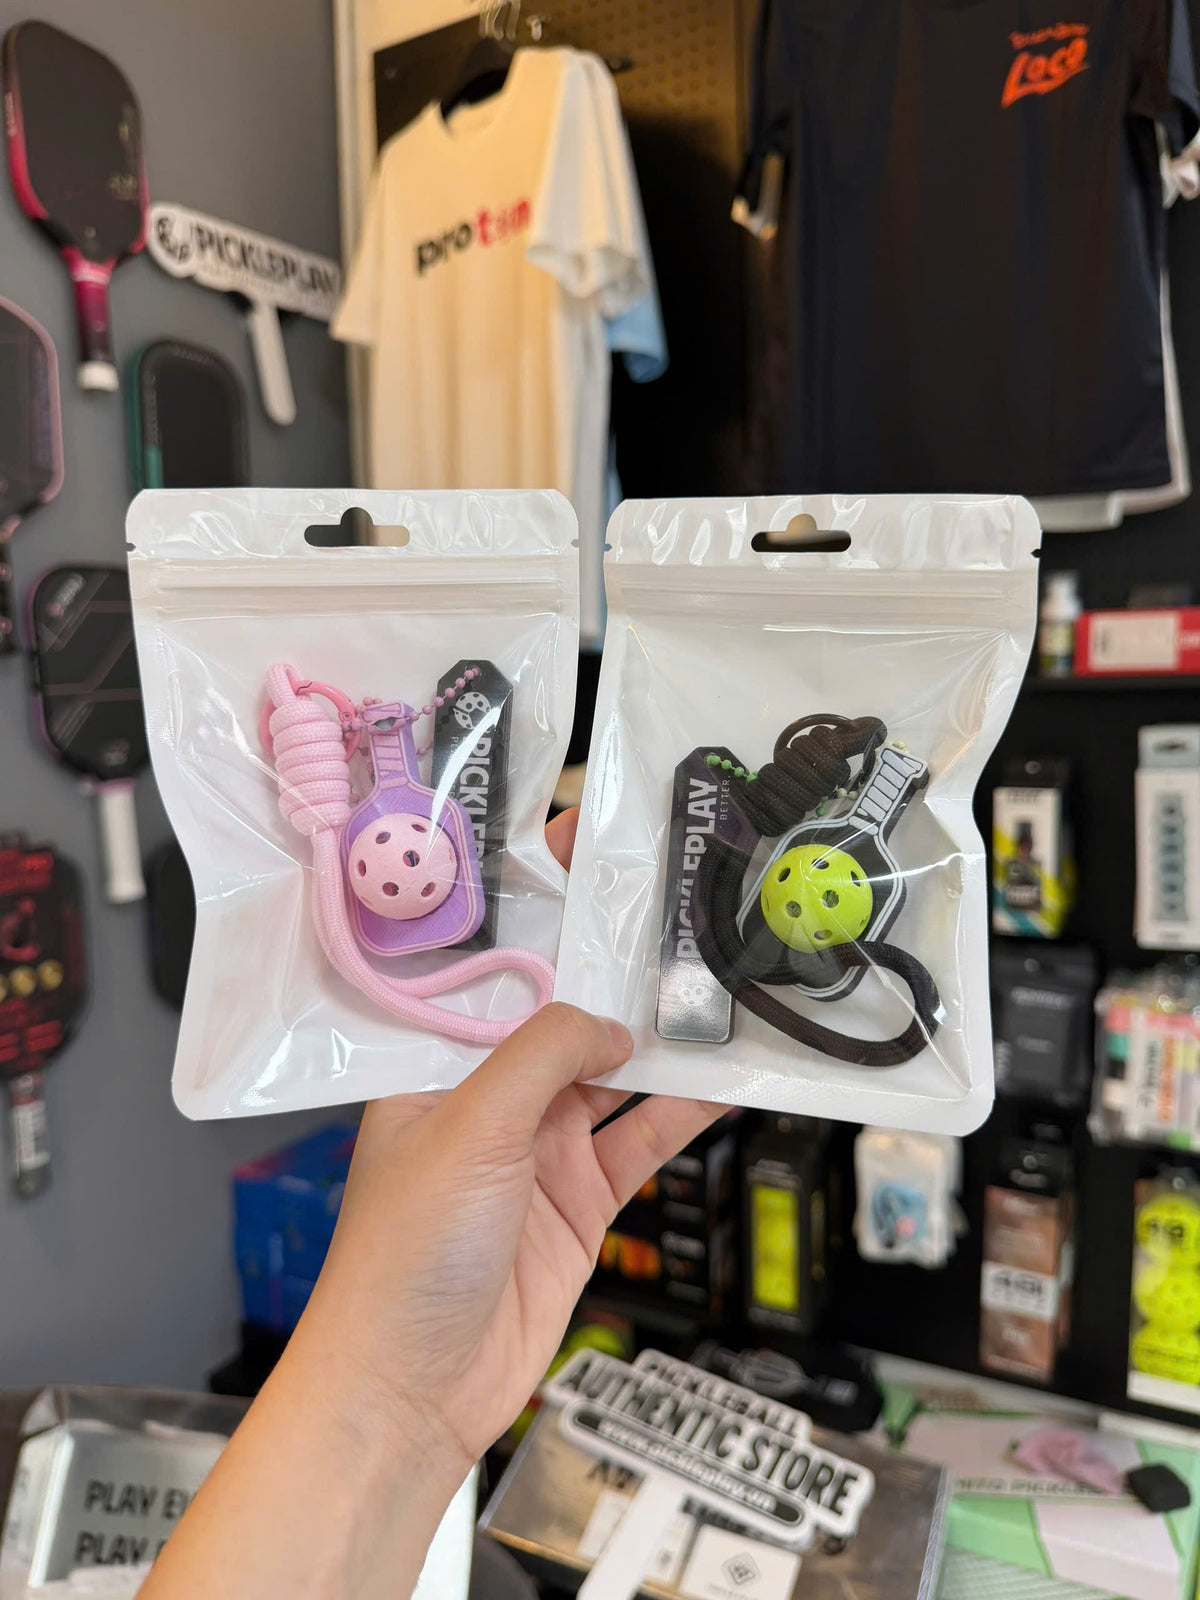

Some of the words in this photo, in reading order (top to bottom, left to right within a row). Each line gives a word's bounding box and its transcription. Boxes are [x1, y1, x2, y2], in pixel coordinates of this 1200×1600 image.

[556, 1359, 742, 1458] AUTHENTIC
[742, 1430, 859, 1517] STORE
[84, 1478, 158, 1518] PLAY
[74, 1531, 149, 1565] PLAY
